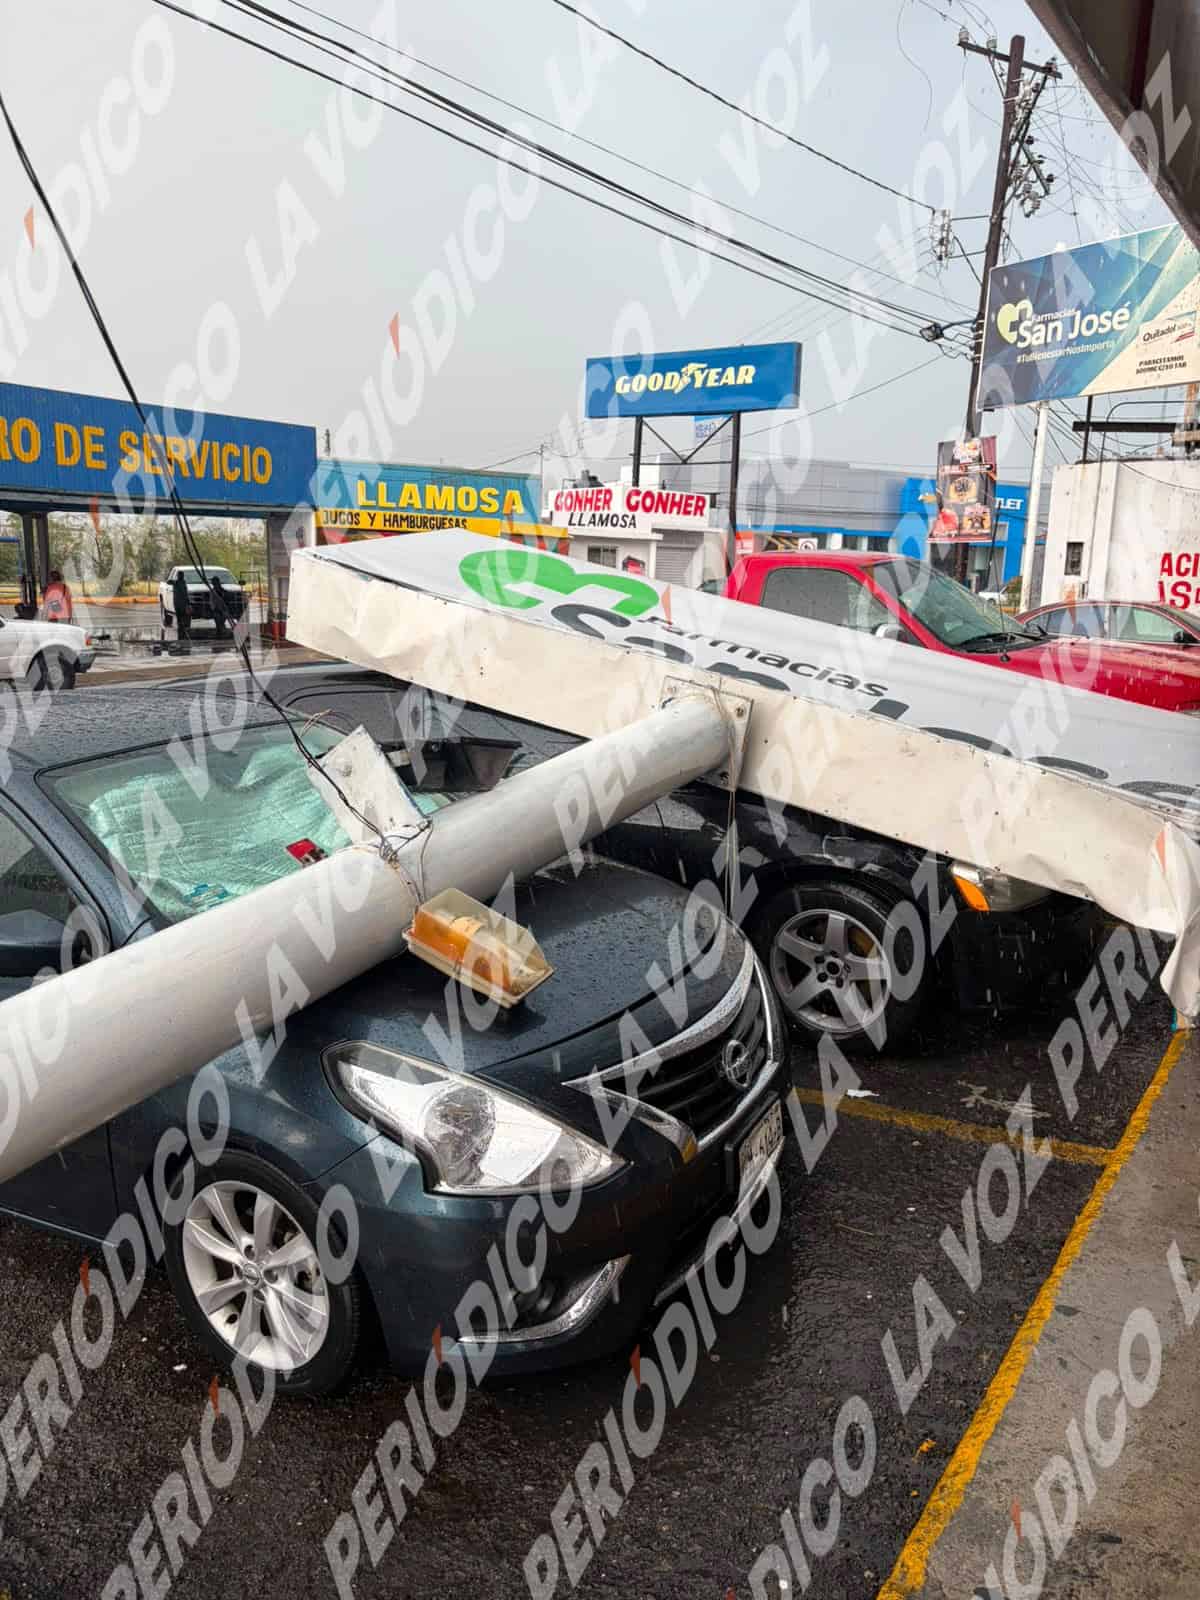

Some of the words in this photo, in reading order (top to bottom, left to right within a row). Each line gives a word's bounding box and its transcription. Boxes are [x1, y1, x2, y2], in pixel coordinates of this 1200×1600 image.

[1016, 320, 1063, 348] San
[1068, 301, 1131, 340] José
[615, 363, 756, 394] GOODYEAR
[54, 422, 107, 470] DE
[119, 430, 273, 485] SERVICIO
[356, 479, 525, 515] LLAMOSA
[554, 488, 613, 512] GONHER
[625, 489, 706, 517] GONHER
[322, 510, 361, 526] JUGOS
[368, 511, 377, 527] Y
[383, 513, 468, 531] HAMBURGUESAS
[567, 512, 637, 528] LLAMOSA
